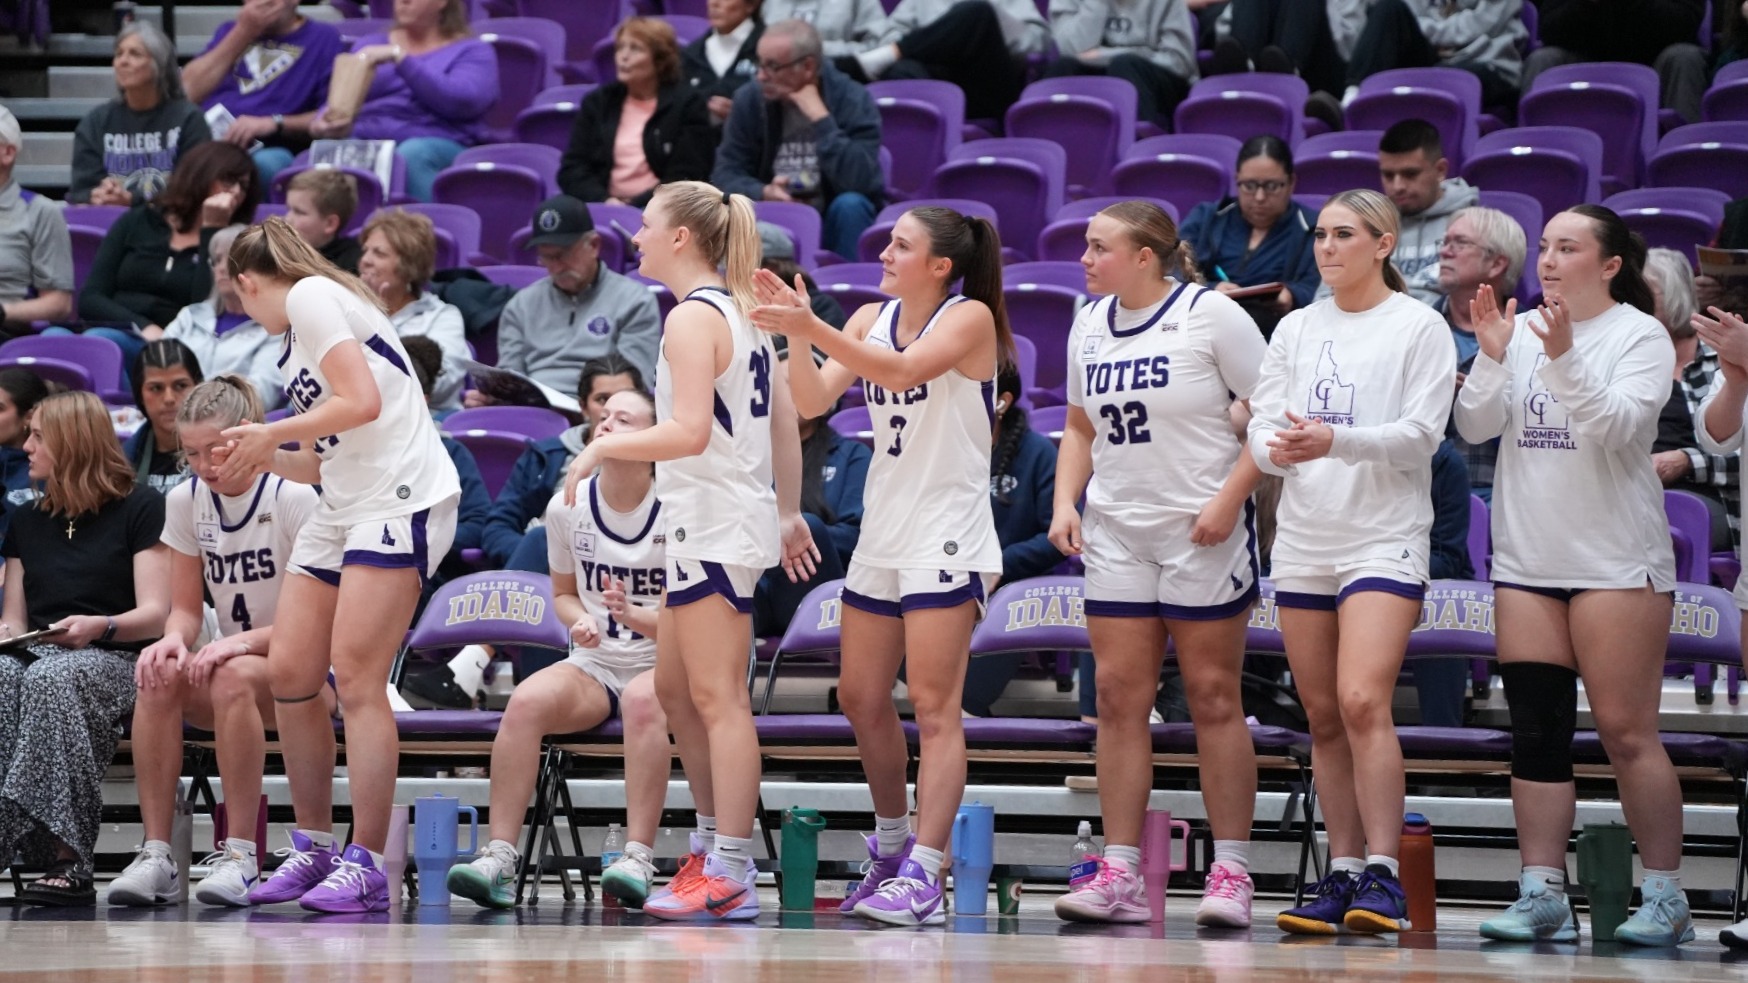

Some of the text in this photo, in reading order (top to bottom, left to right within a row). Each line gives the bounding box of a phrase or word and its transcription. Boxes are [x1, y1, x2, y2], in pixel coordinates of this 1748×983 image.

[103, 132, 162, 154] COLLEGE
[1086, 355, 1169, 397] YOTES
[887, 415, 907, 457] 3
[1100, 400, 1152, 446] 32
[1523, 430, 1570, 440] WOMEN'S
[1517, 439, 1577, 450] BASKETBALL
[466, 581, 520, 593] COLLEGE
[1025, 583, 1080, 598] COLLEGE
[1424, 589, 1476, 600] OLLEGE
[231, 592, 252, 632] 4
[445, 590, 546, 626] IDAHO
[1005, 595, 1087, 632] IDAH
[1411, 599, 1496, 636] DAH
